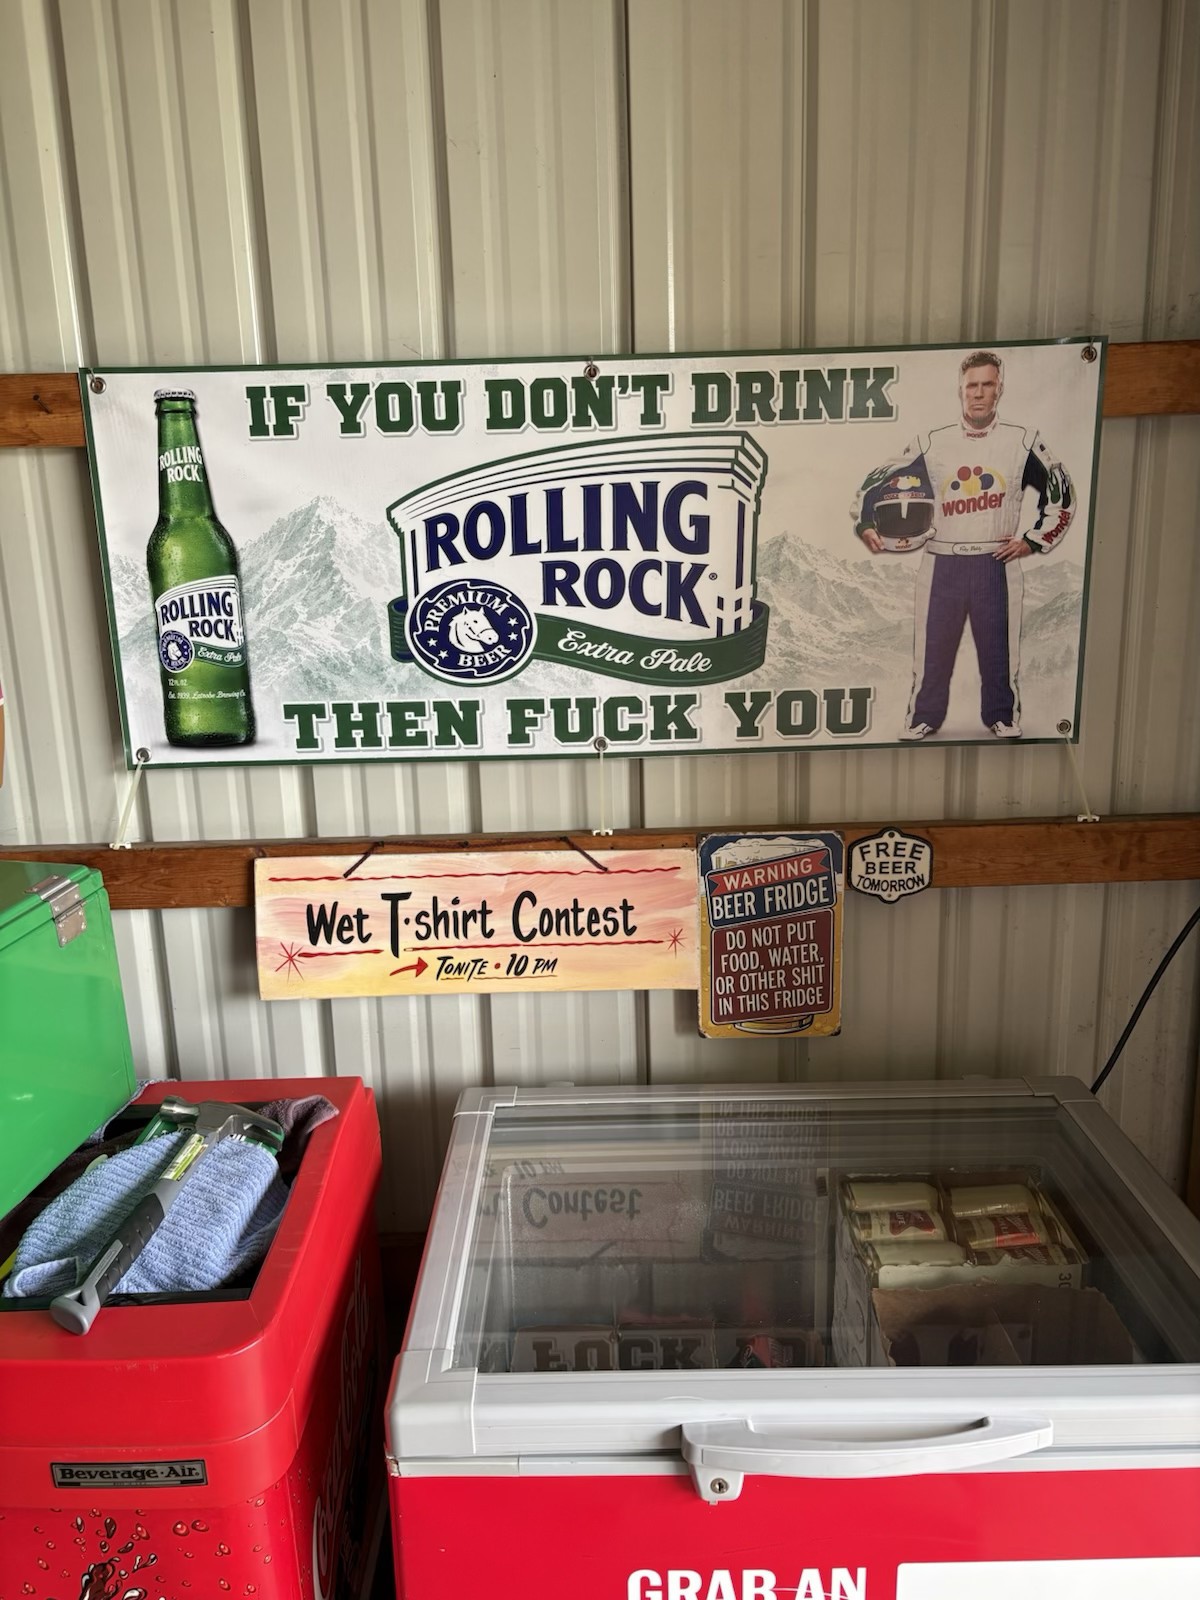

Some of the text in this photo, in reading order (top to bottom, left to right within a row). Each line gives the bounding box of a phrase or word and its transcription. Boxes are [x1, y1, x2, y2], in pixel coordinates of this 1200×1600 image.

[246, 365, 898, 439] IF YOU DON'T DRINK
[159, 446, 203, 471] ROLLING
[167, 465, 203, 483] ROCK
[941, 491, 1006, 517] wonder
[422, 480, 710, 573] ROLLING
[160, 591, 233, 626] ROLLING
[424, 590, 510, 632] PREMIUM
[198, 646, 222, 661] Extra
[457, 645, 512, 667] BEER
[557, 628, 713, 673] Extra Pale
[283, 687, 873, 751] THEN FUCK YOU
[859, 841, 926, 862] FREE
[723, 857, 813, 891] WARNING
[857, 873, 925, 893] TOMORROW
[865, 861, 917, 875] BEER
[713, 876, 829, 920] BEER FRIDGE
[306, 901, 372, 946] Wet
[511, 890, 637, 943] Contest
[726, 920, 816, 950] DO NOT PUT
[506, 953, 529, 977] 10
[532, 957, 558, 975] PM
[721, 943, 825, 973] FOOD, WATER,
[715, 964, 825, 995] OR OTHER SHIT
[718, 986, 825, 1016] IN THIS FRIDGE
[627, 1567, 867, 1600] GRAB AN
